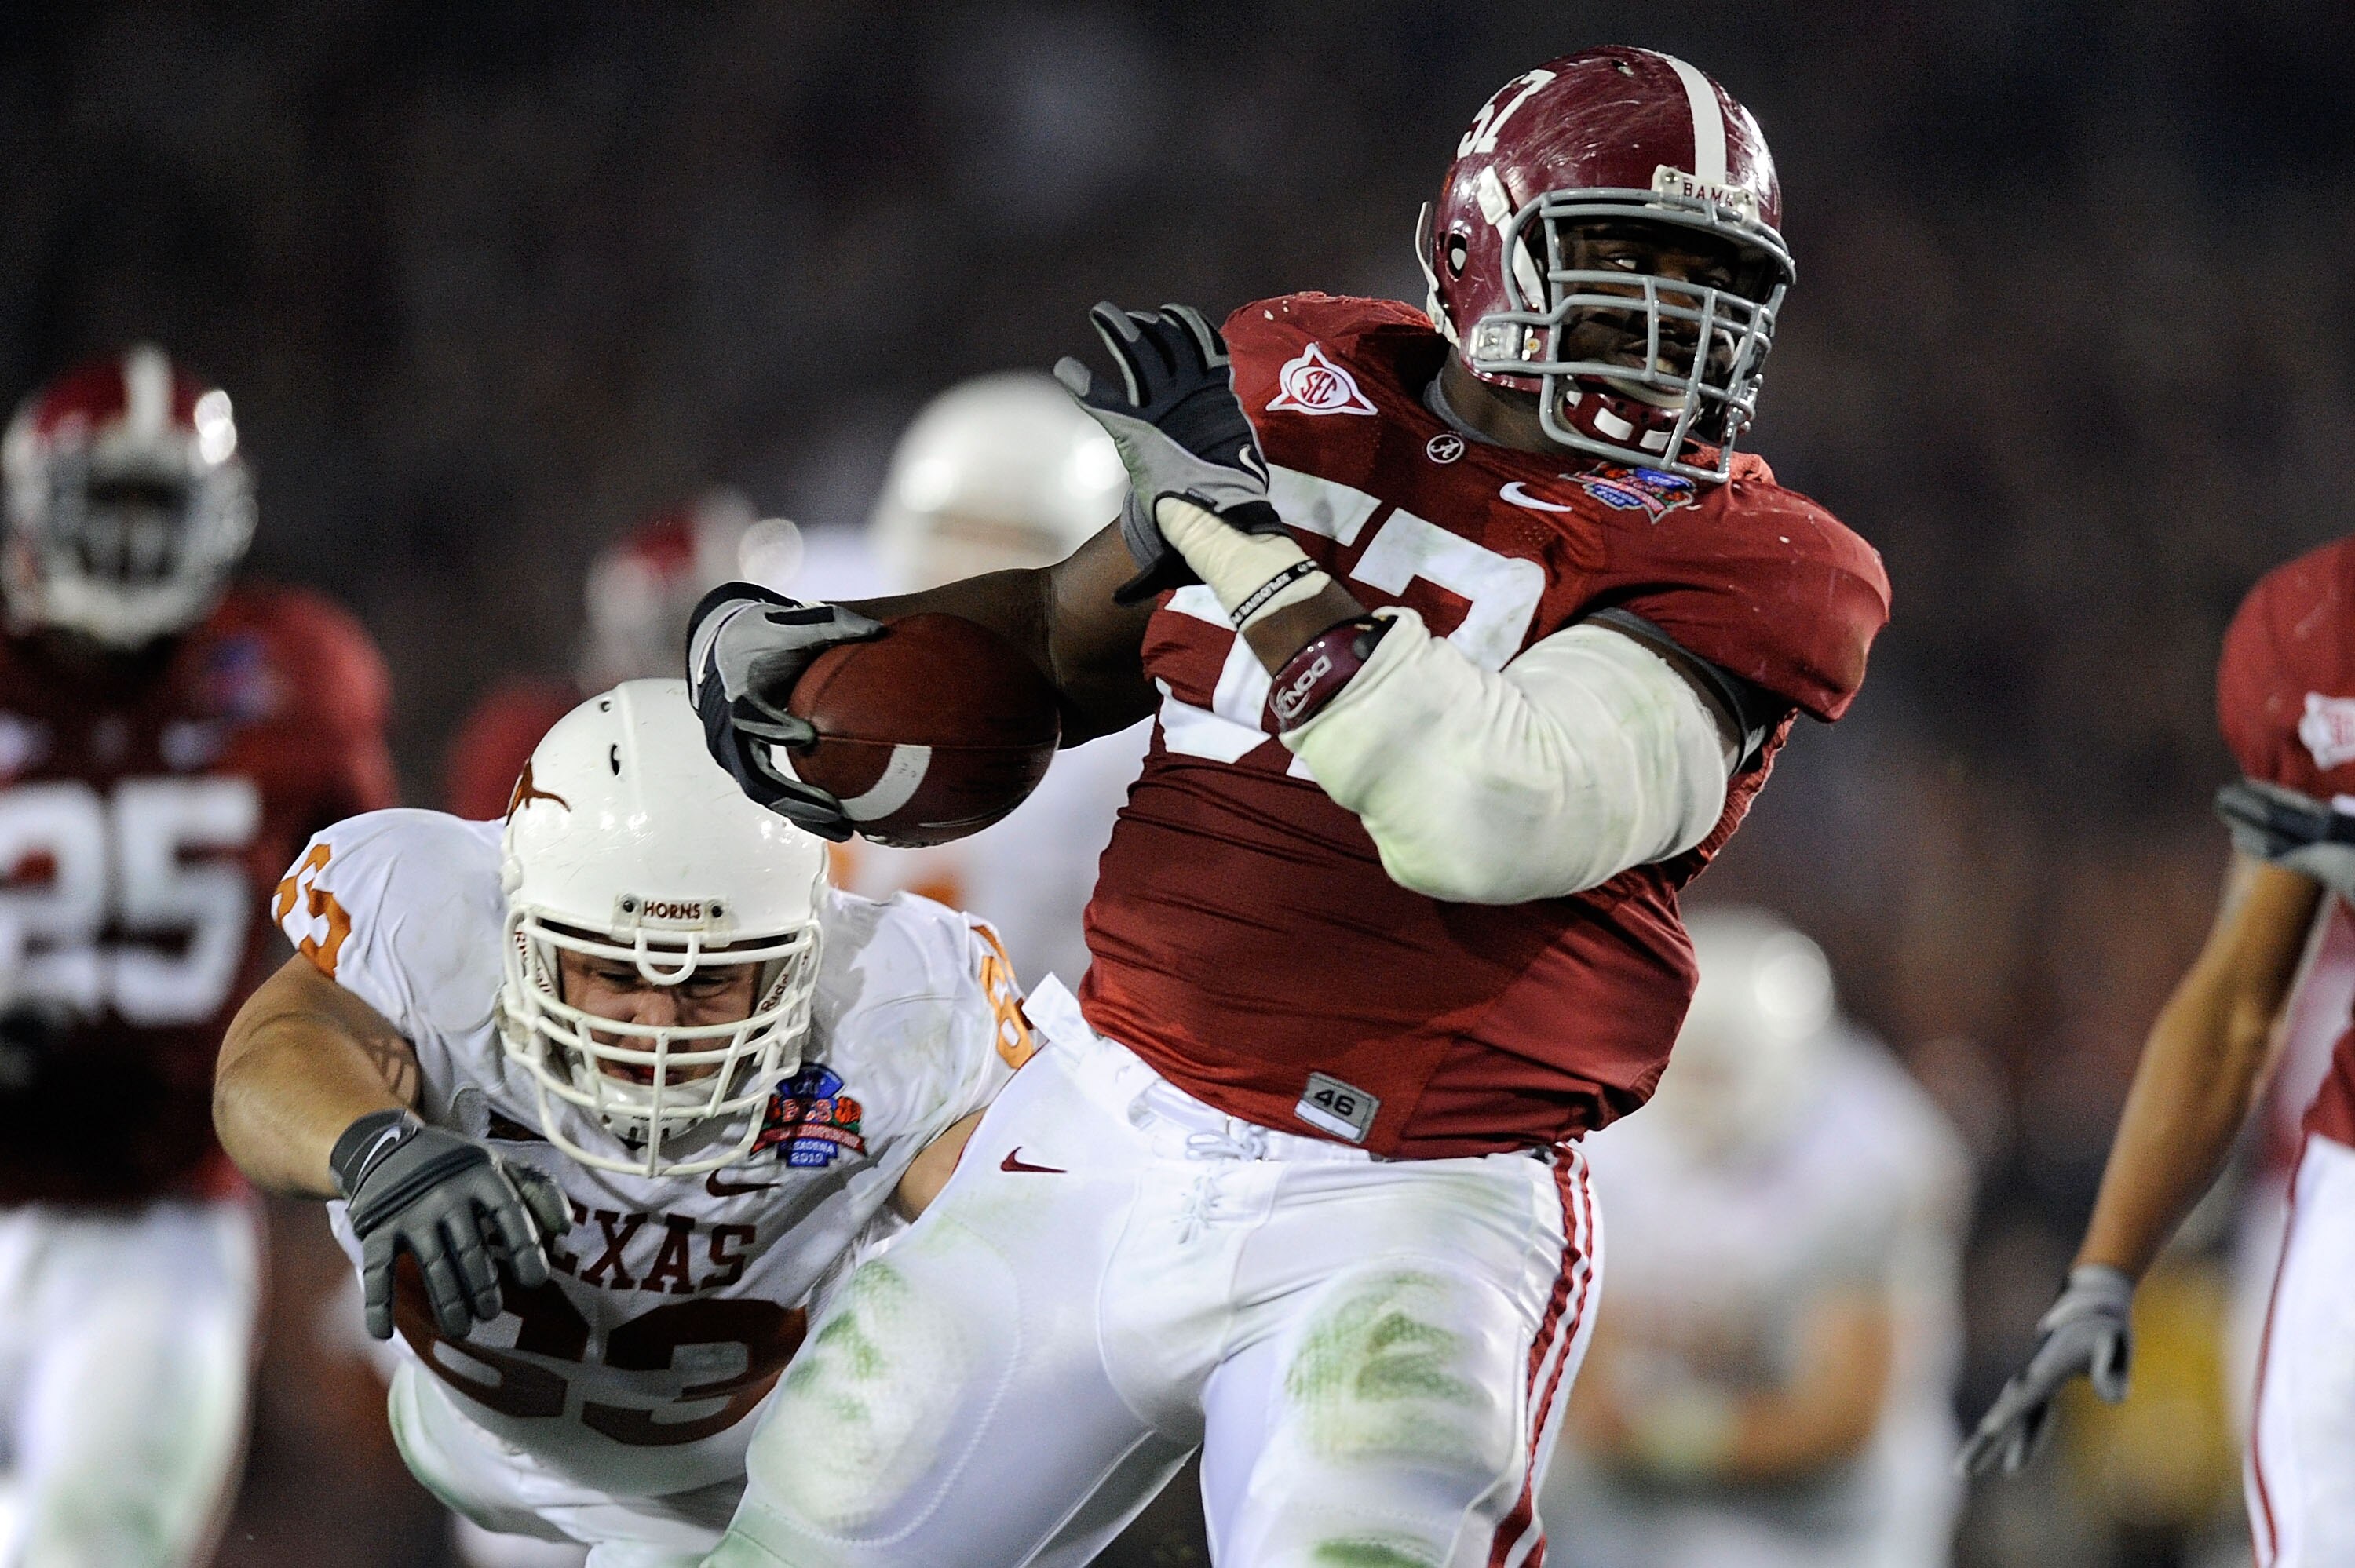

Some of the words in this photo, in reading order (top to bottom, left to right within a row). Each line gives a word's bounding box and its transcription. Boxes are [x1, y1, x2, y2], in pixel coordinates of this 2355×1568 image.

[1299, 370, 1338, 405] SEC
[0, 775, 261, 1024] 25
[644, 901, 700, 919] HORNS
[1314, 1089, 1356, 1116] 46
[791, 1153, 824, 1163] 2010
